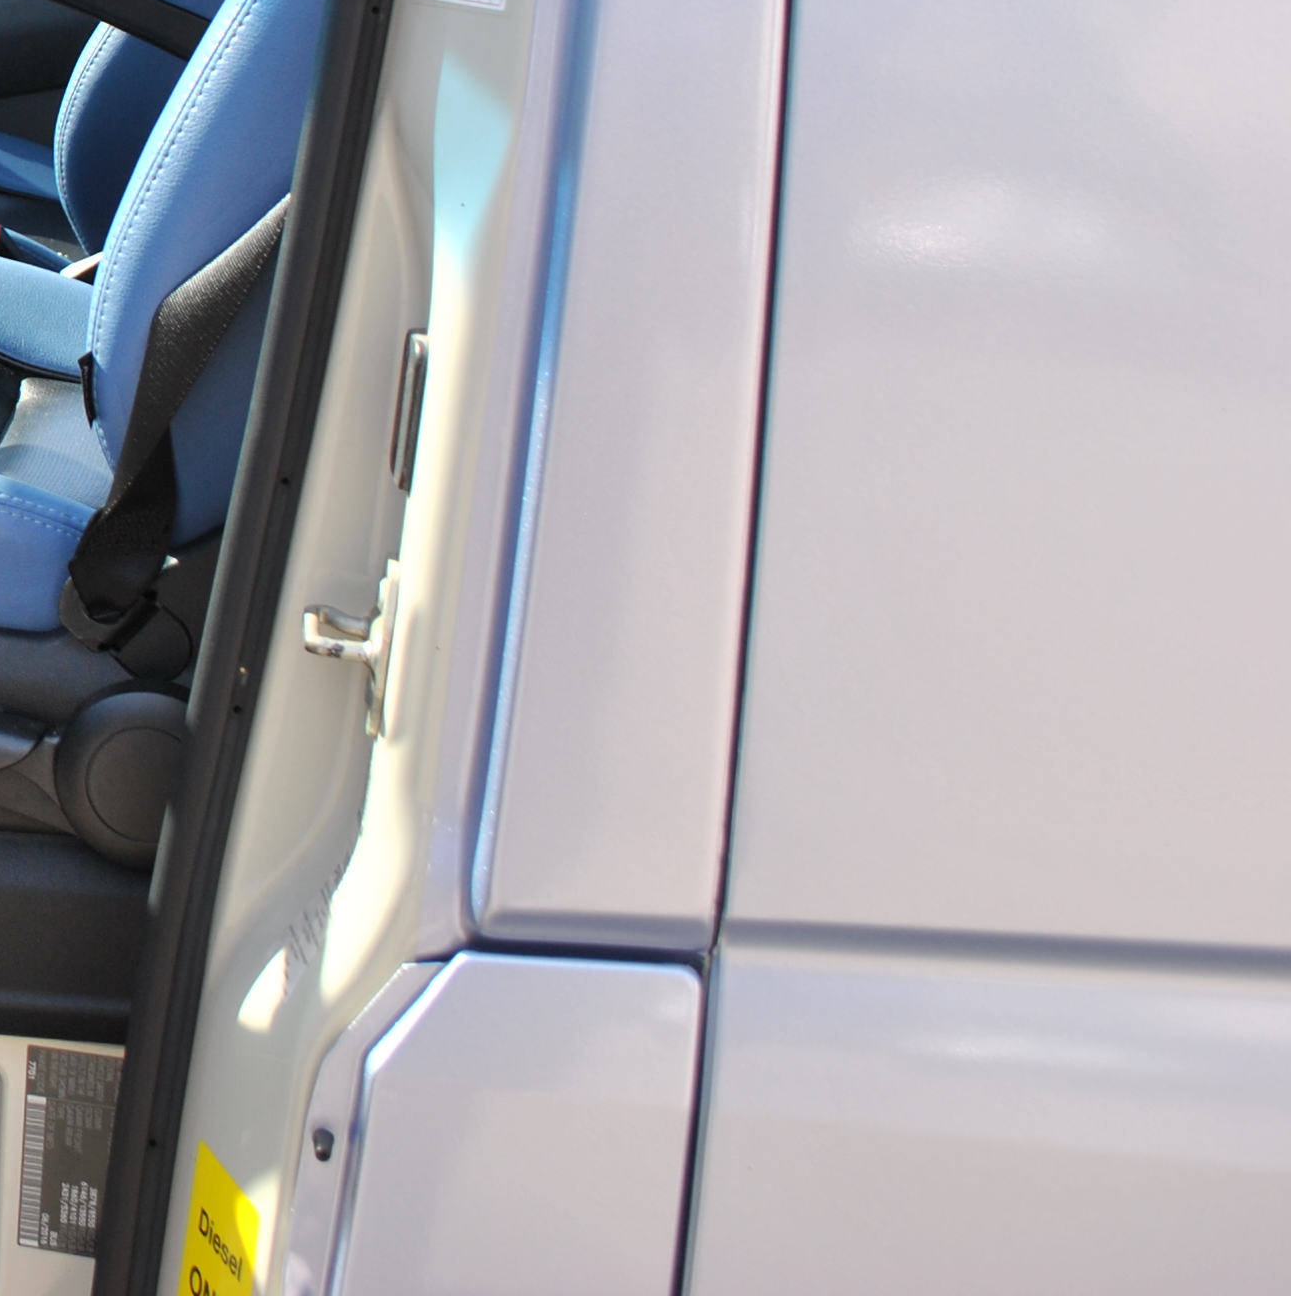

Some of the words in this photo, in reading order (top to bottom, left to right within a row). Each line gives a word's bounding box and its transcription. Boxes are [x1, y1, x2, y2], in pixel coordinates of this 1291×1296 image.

[27, 1059, 36, 1080] 7701
[49, 1230, 57, 1247] BUS
[198, 1206, 243, 1282] Diesel
